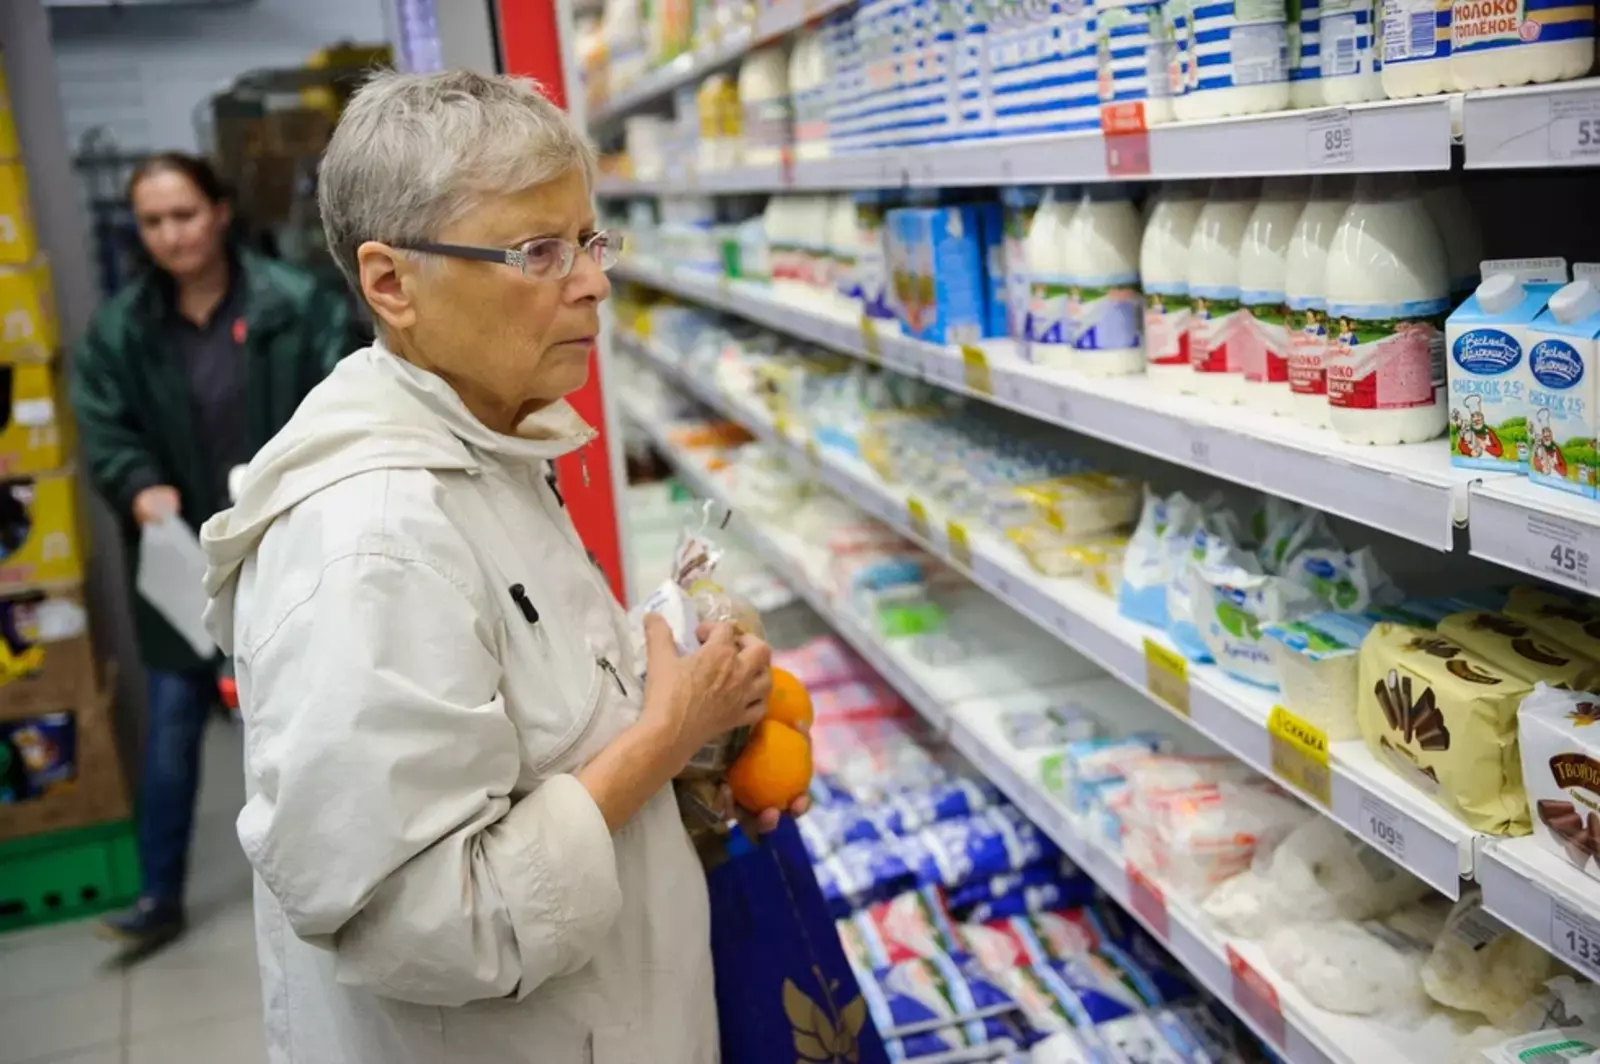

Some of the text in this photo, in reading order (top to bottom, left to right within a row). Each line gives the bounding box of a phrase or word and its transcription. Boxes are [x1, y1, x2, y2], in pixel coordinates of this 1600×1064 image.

[1455, 0, 1517, 20] МОЛОКО
[1325, 129, 1342, 150] 89
[1453, 379, 1500, 395] СНЕЖОК
[1550, 544, 1576, 571] 45
[1284, 719, 1324, 752] СКИДКА
[1370, 816, 1396, 845] 109
[1566, 930, 1600, 967] 133
